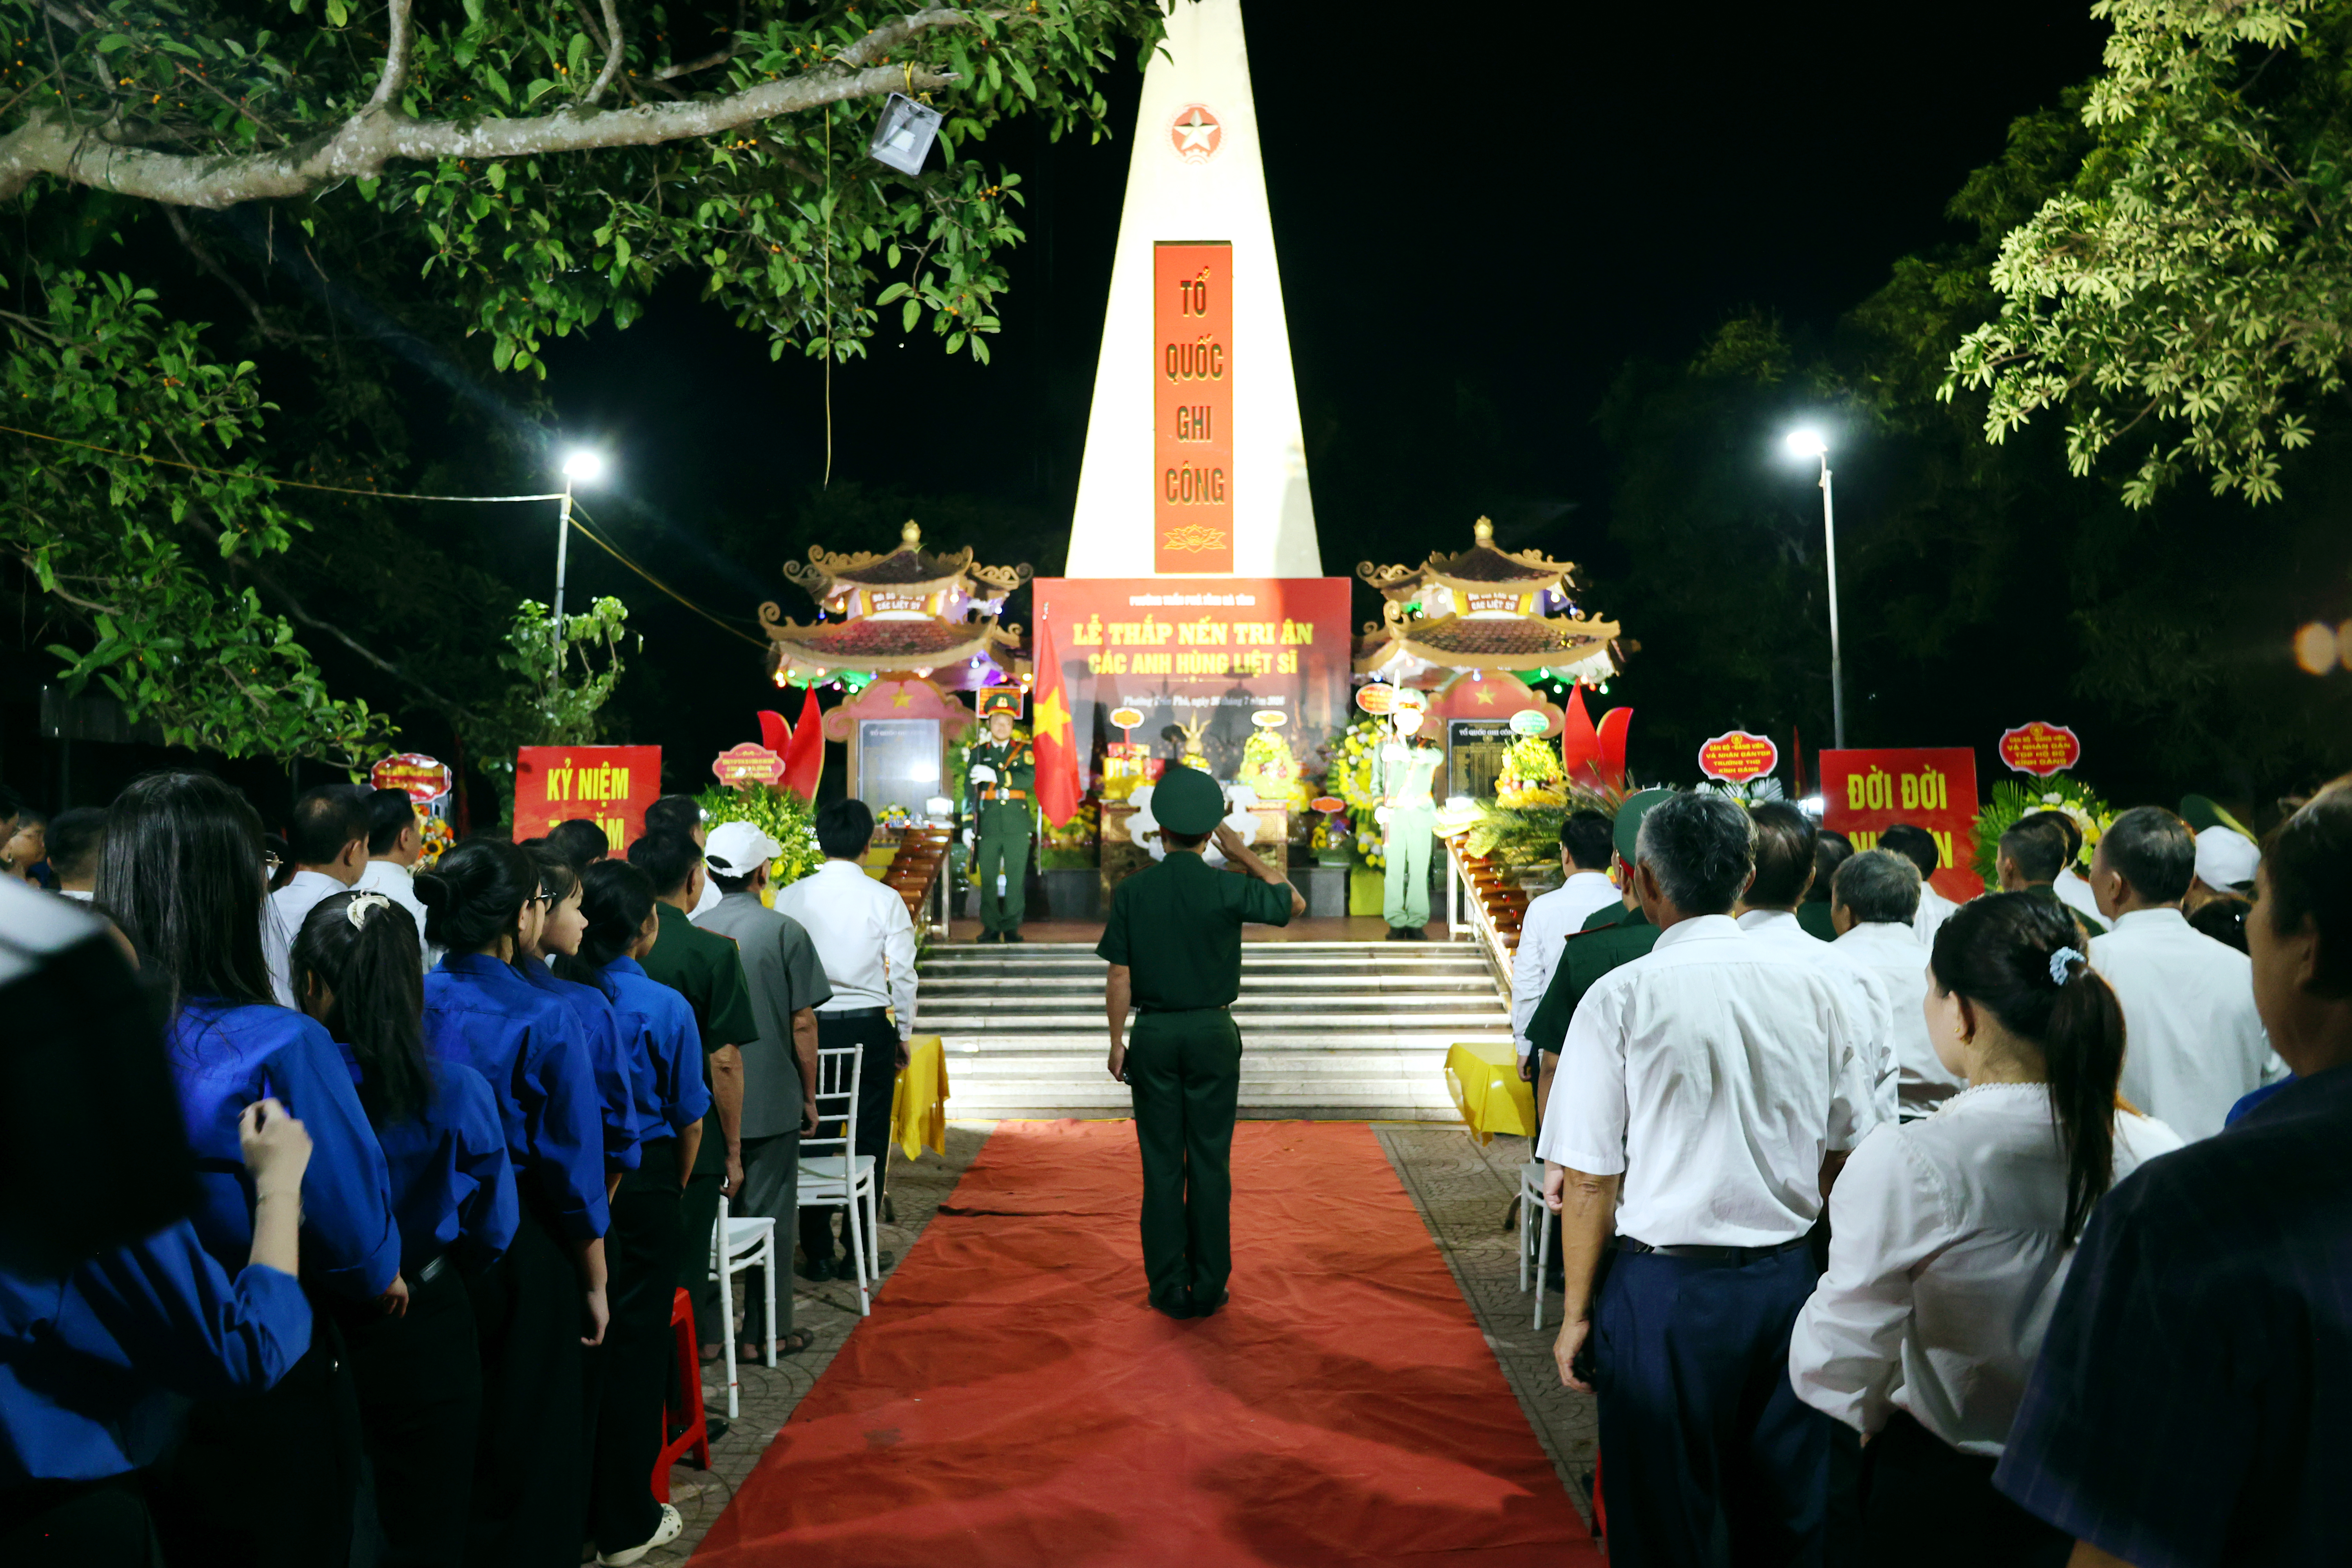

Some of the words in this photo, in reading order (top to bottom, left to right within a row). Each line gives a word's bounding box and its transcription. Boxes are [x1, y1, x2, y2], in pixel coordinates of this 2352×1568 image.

[1180, 266, 1210, 318] TỔ
[1165, 334, 1224, 385] QUỐC
[1177, 406, 1212, 443] GHI
[1165, 461, 1225, 505] CÔNG
[1073, 613, 1103, 645] LỄ
[1178, 615, 1227, 645] NẾN
[1233, 623, 1275, 645] TRI
[1280, 618, 1313, 645] ÂN
[1089, 650, 1127, 674] CÁC
[1131, 653, 1172, 674] ANH
[1176, 650, 1229, 674] HÙNG
[1234, 649, 1273, 678] LIỆT
[1277, 650, 1297, 674] SĨ
[547, 757, 573, 801] KỶ
[578, 761, 629, 808] NIỆM
[1847, 764, 1893, 810] ĐỜI
[1901, 764, 1947, 810] ĐỜI
